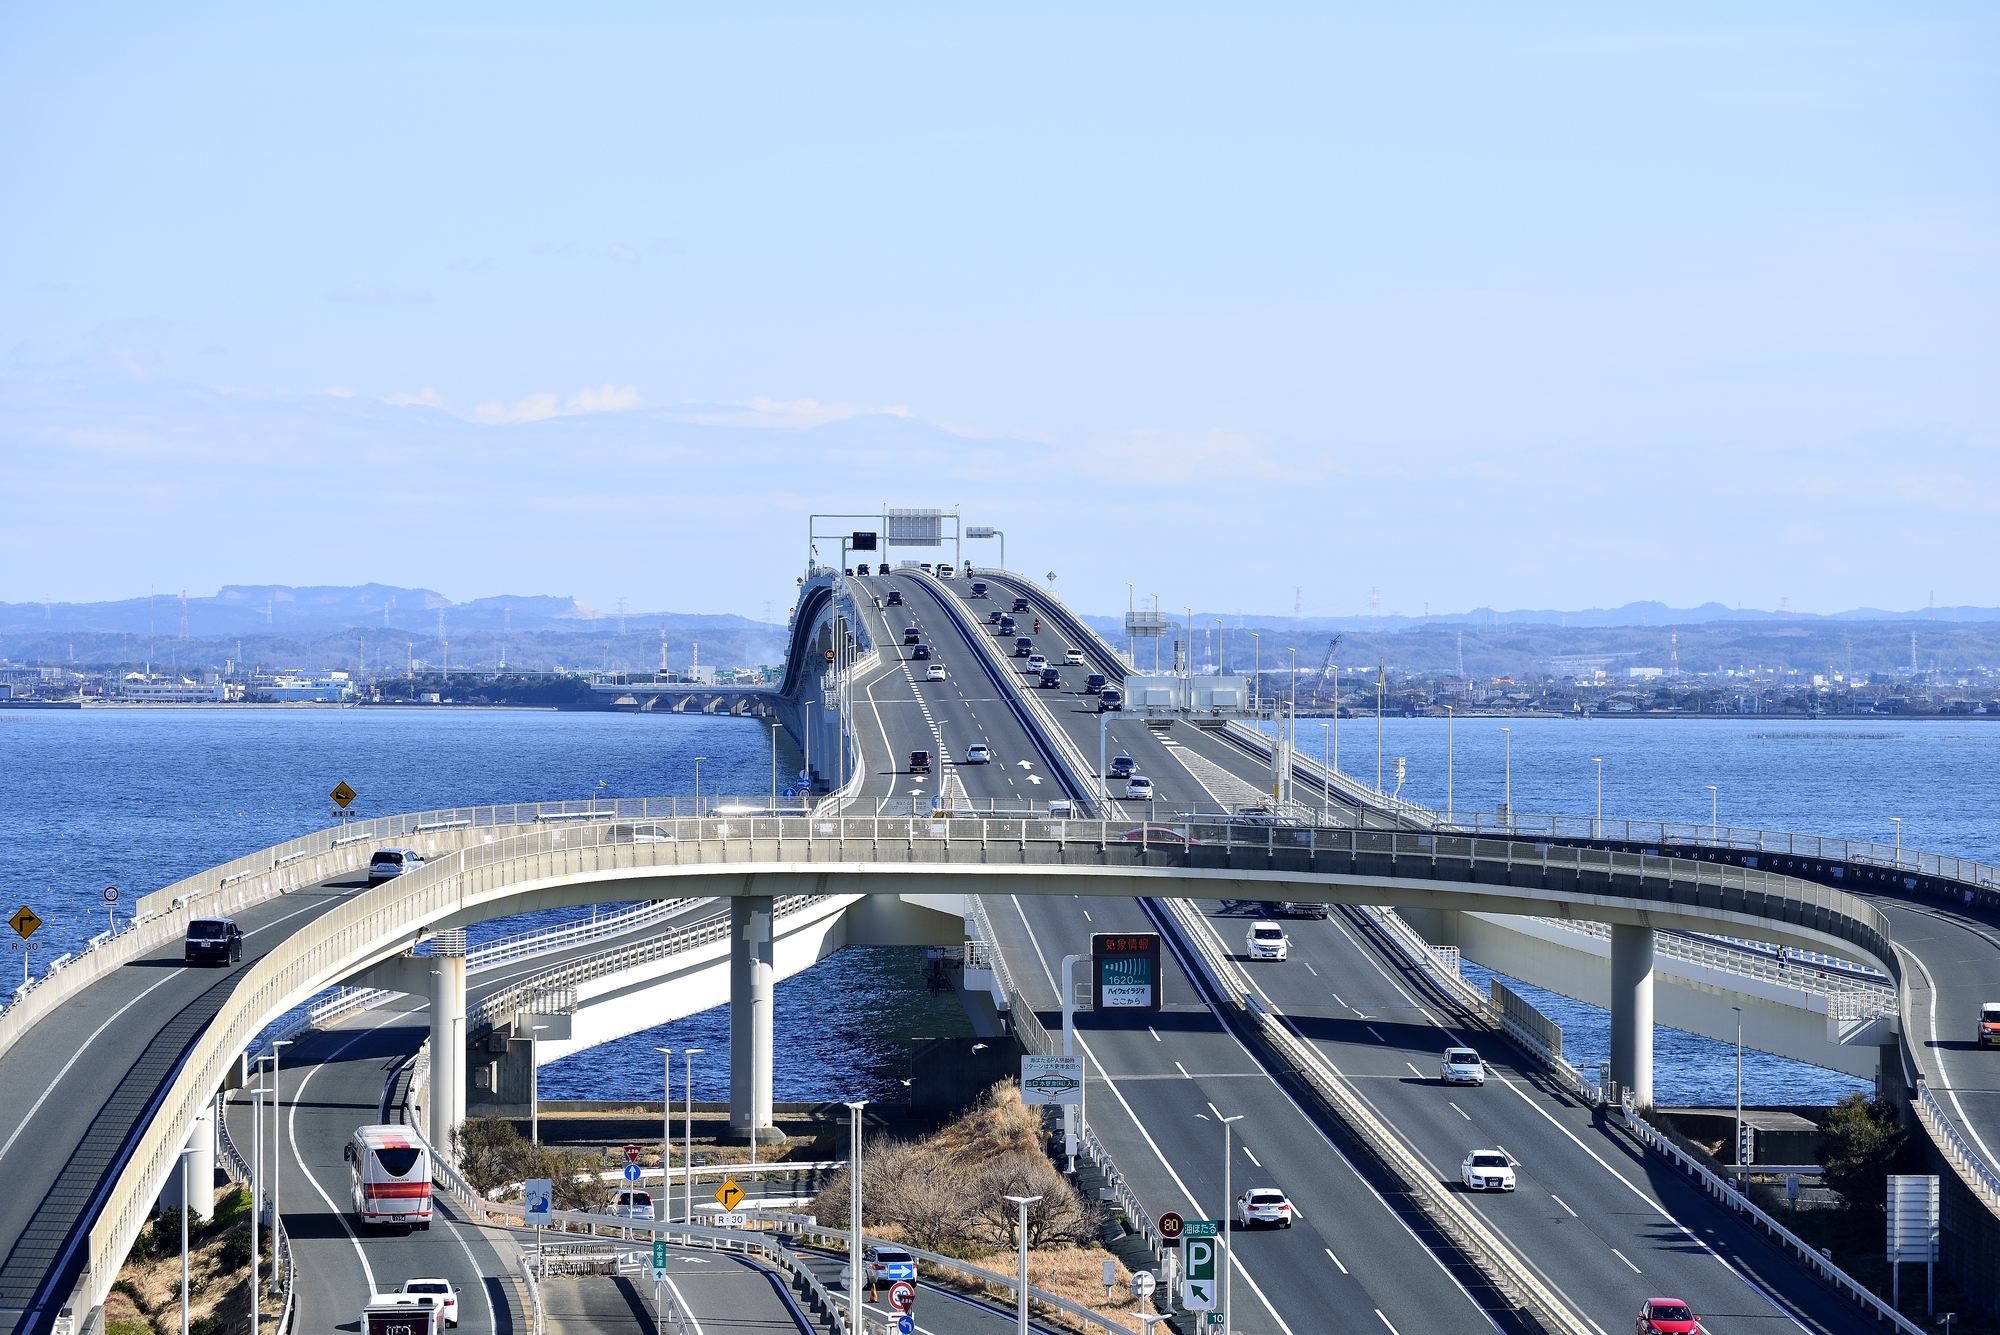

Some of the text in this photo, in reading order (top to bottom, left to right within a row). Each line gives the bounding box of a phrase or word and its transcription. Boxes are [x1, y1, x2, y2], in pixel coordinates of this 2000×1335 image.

[1105, 938, 1149, 951] 気象情報
[1109, 975, 1134, 985] 1620
[1107, 987, 1146, 995] ハイウェイラジオ
[1112, 997, 1141, 1005] ここから
[1164, 1218, 1179, 1231] 80
[1184, 1224, 1217, 1234] 海ほたる
[656, 1244, 664, 1267] 木更津
[1190, 1242, 1212, 1276] P
[1212, 1314, 1224, 1323] 10
